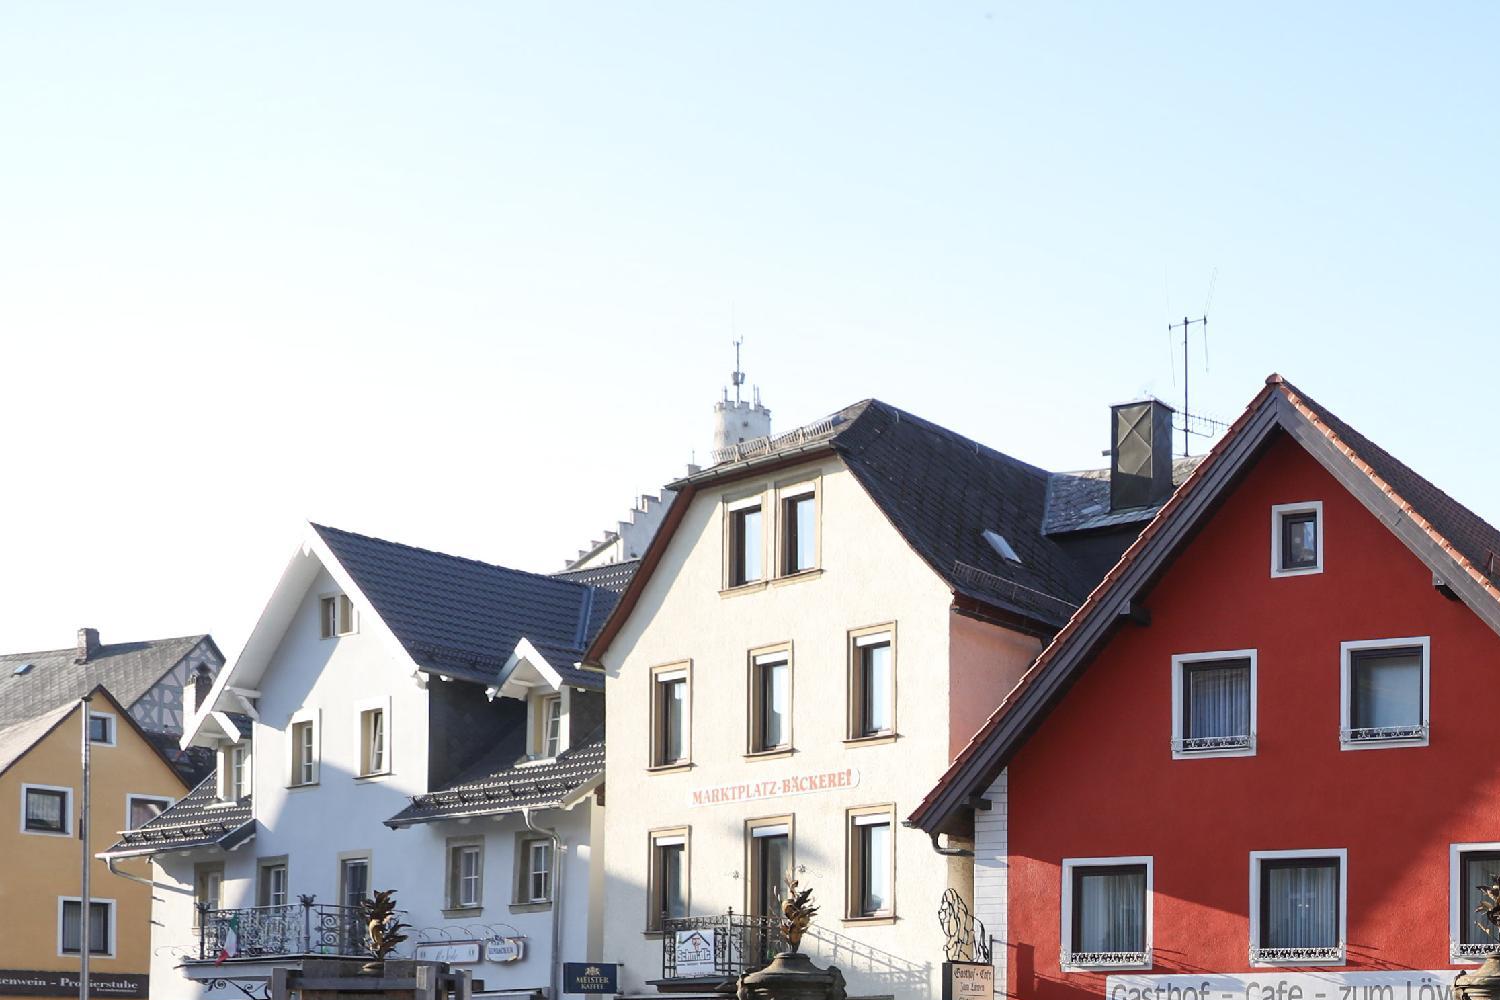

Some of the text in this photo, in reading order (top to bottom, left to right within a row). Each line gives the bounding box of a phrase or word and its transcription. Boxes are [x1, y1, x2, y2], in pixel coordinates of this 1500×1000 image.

[692, 768, 852, 805] MARKTPLATZ-BÄCKEREI
[0, 977, 46, 987] enwein
[60, 977, 139, 989] Proierstube
[576, 976, 608, 984] MEISTER
